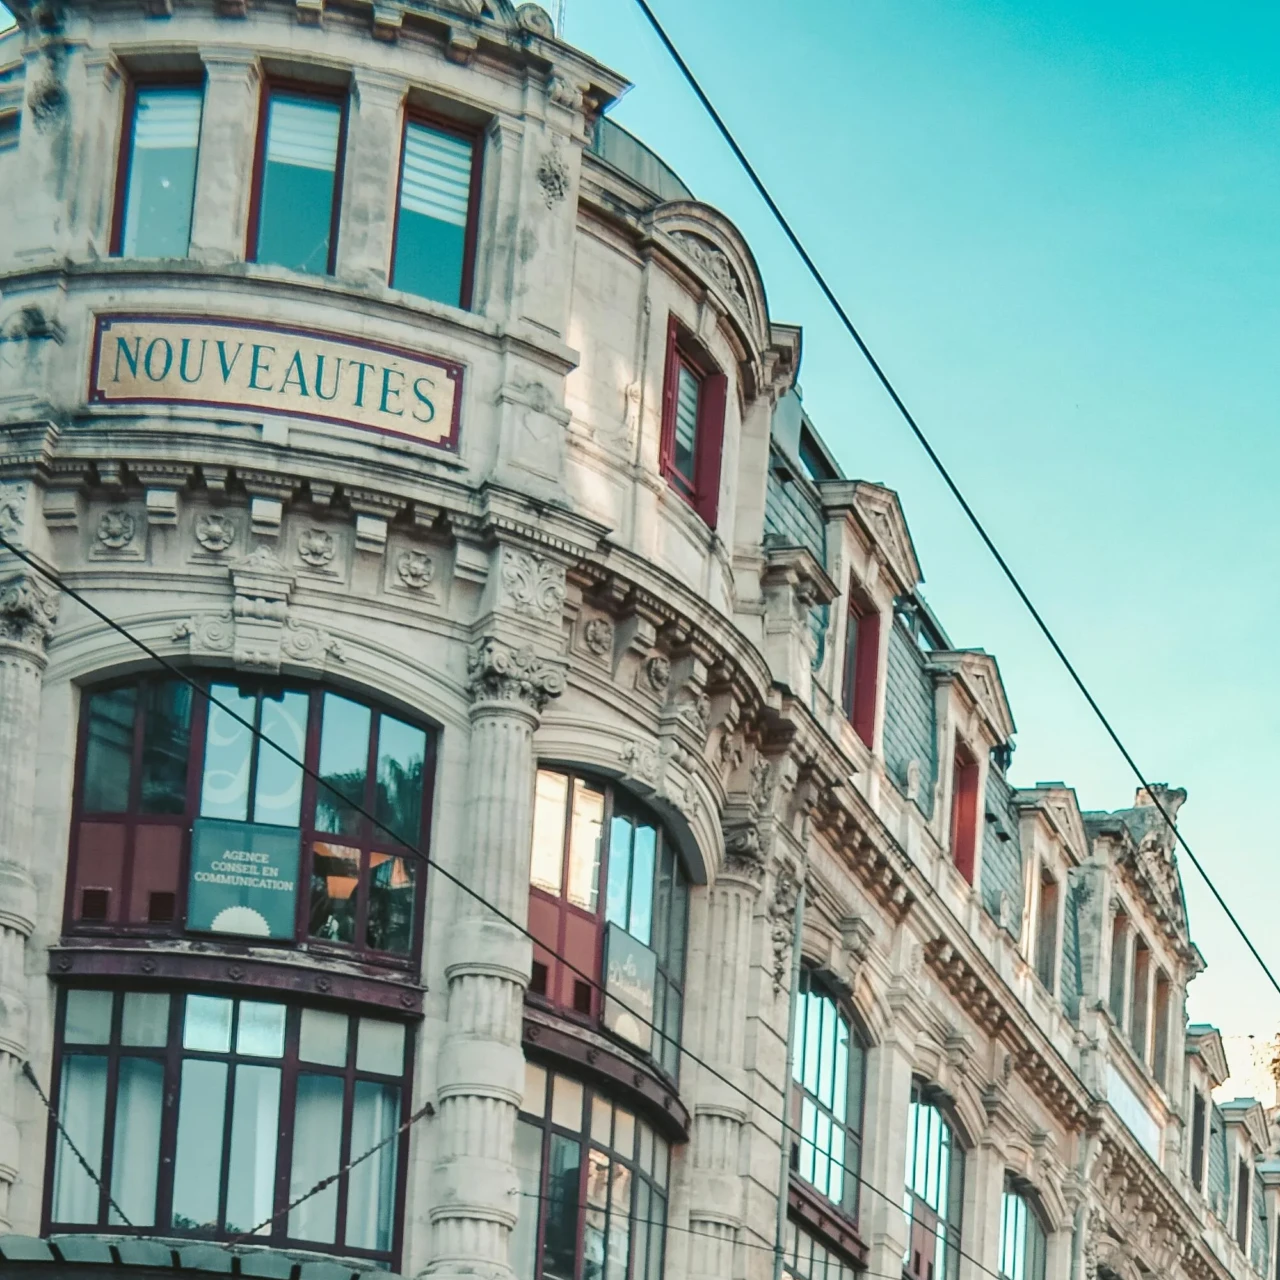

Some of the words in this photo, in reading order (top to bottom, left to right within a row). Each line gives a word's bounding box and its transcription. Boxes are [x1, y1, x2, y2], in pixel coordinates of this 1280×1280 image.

[113, 336, 437, 423] NOUVEAUTÉS
[222, 850, 270, 864] AGENCE
[211, 861, 260, 875] CONSEIL
[262, 866, 279, 877] EN
[194, 871, 294, 892] COMMUNICATION
